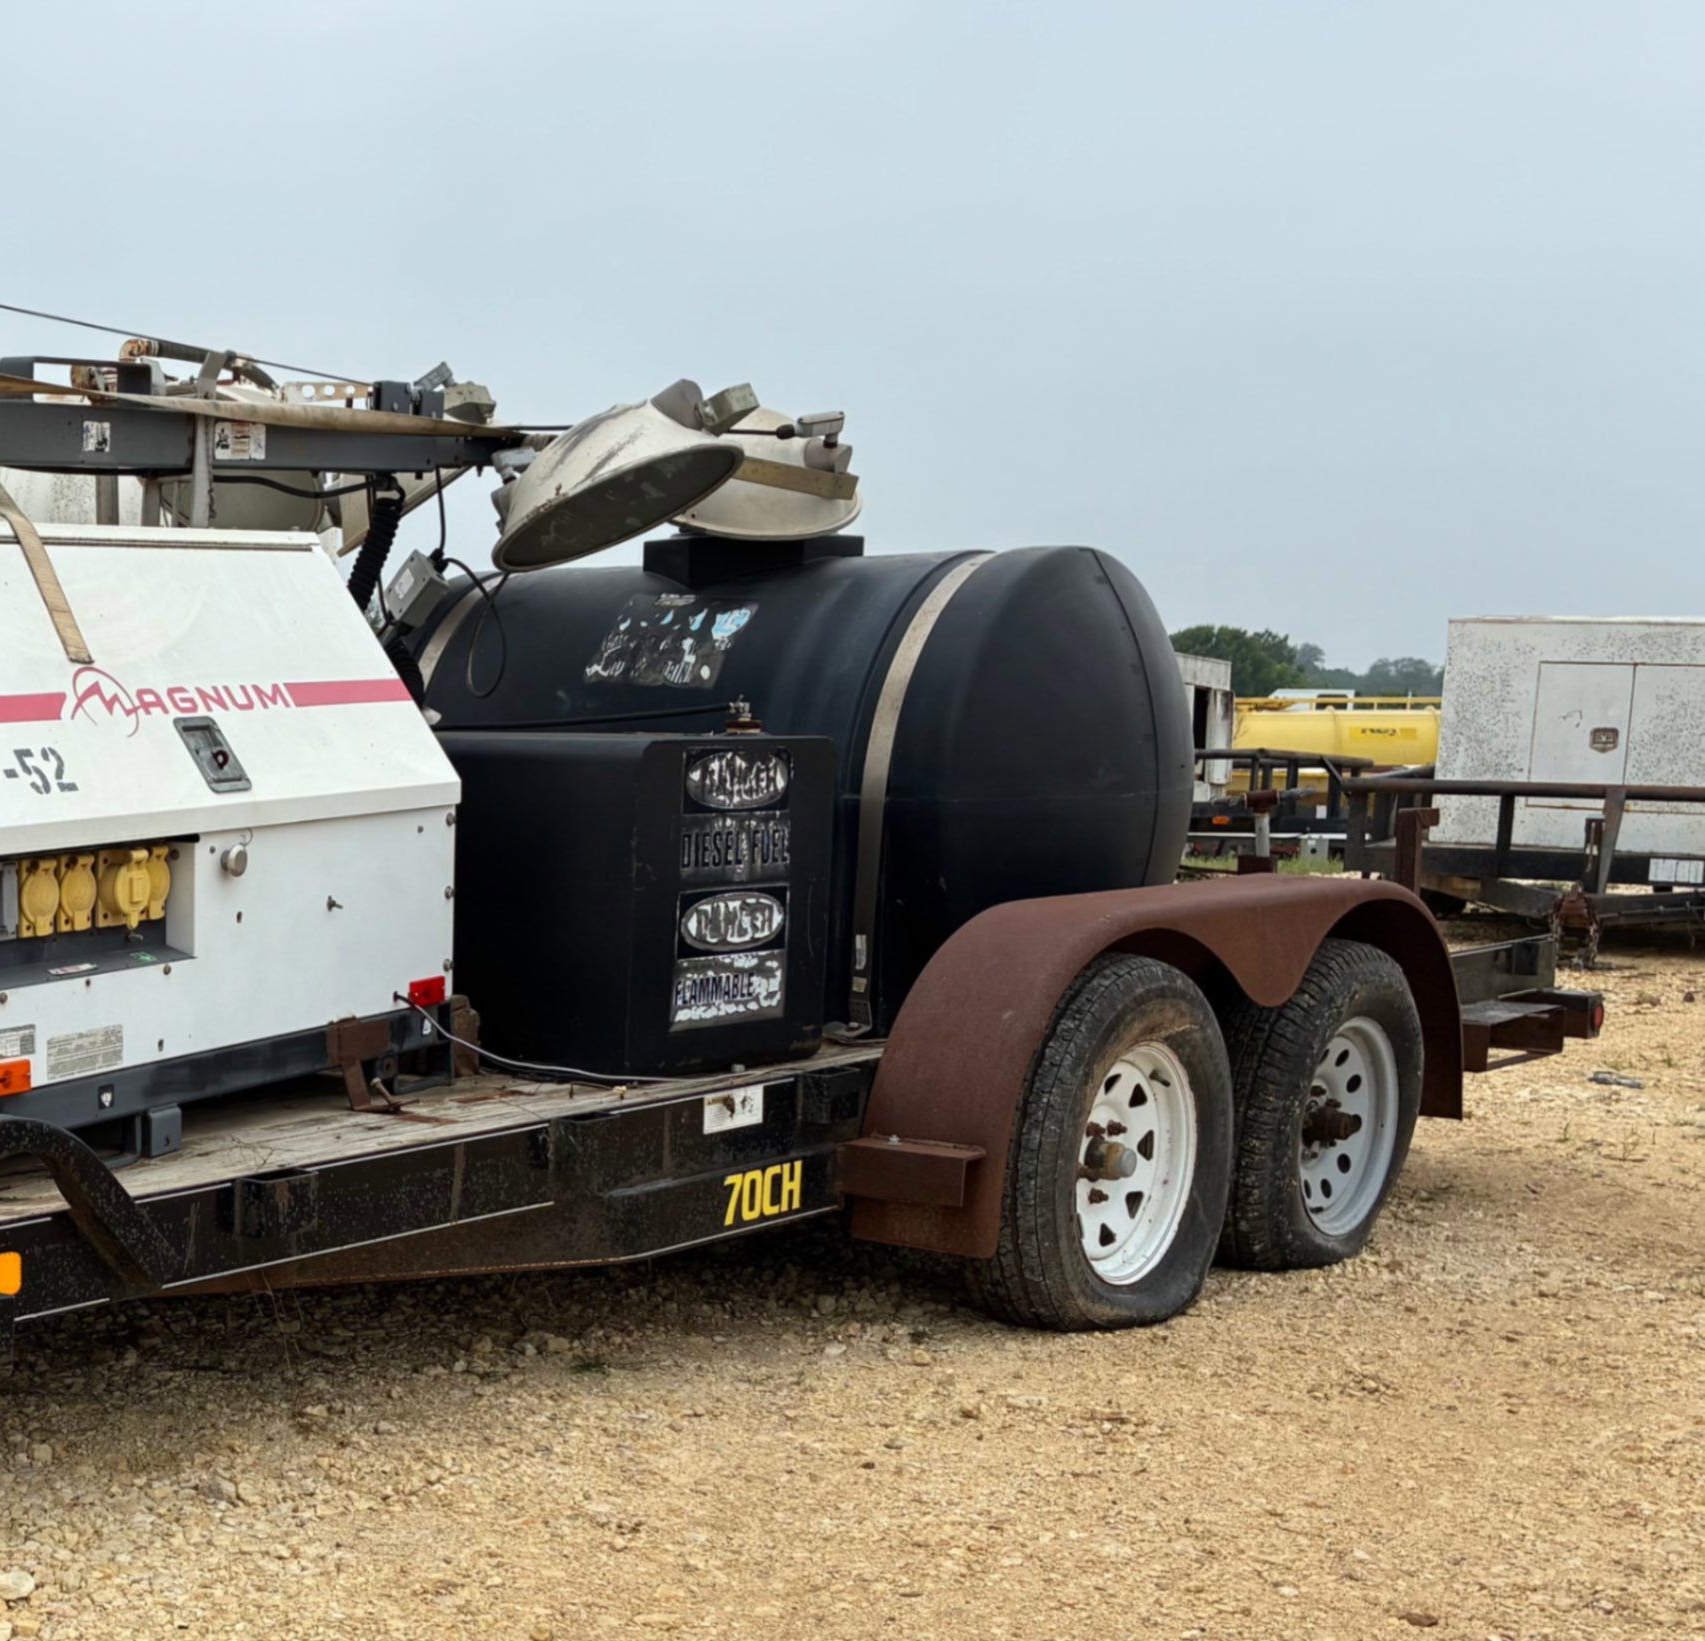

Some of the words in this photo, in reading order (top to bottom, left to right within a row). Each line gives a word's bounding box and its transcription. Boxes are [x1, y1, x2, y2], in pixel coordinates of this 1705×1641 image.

[71, 679, 293, 721] MAGNUM
[682, 829, 745, 868] DIESEL
[751, 827, 791, 865] FUEL
[676, 972, 756, 1004] FLAMMABLE
[724, 1160, 802, 1227] 70CH
